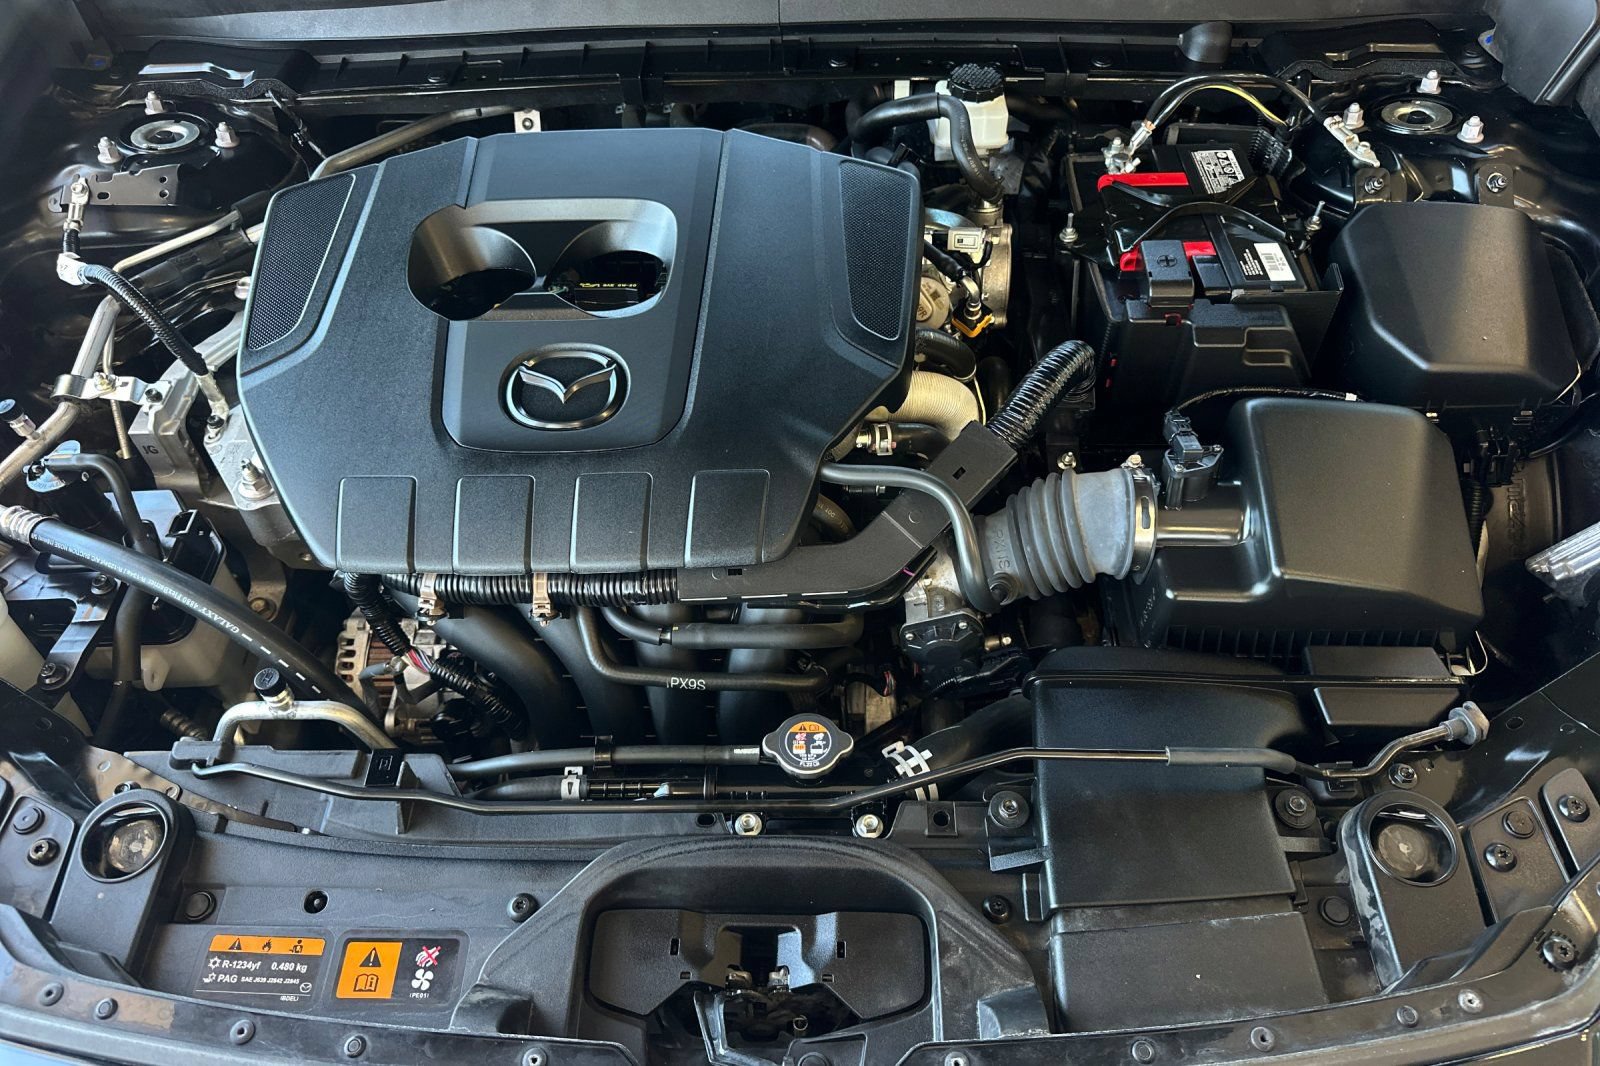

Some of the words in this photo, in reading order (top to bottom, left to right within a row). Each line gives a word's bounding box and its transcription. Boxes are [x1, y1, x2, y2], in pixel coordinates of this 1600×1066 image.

[202, 608, 240, 634] GALAXY
[221, 960, 261, 971] R-1234yf
[271, 962, 295, 971] 0.480
[296, 963, 308, 973] kg
[217, 974, 238, 983] PAG
